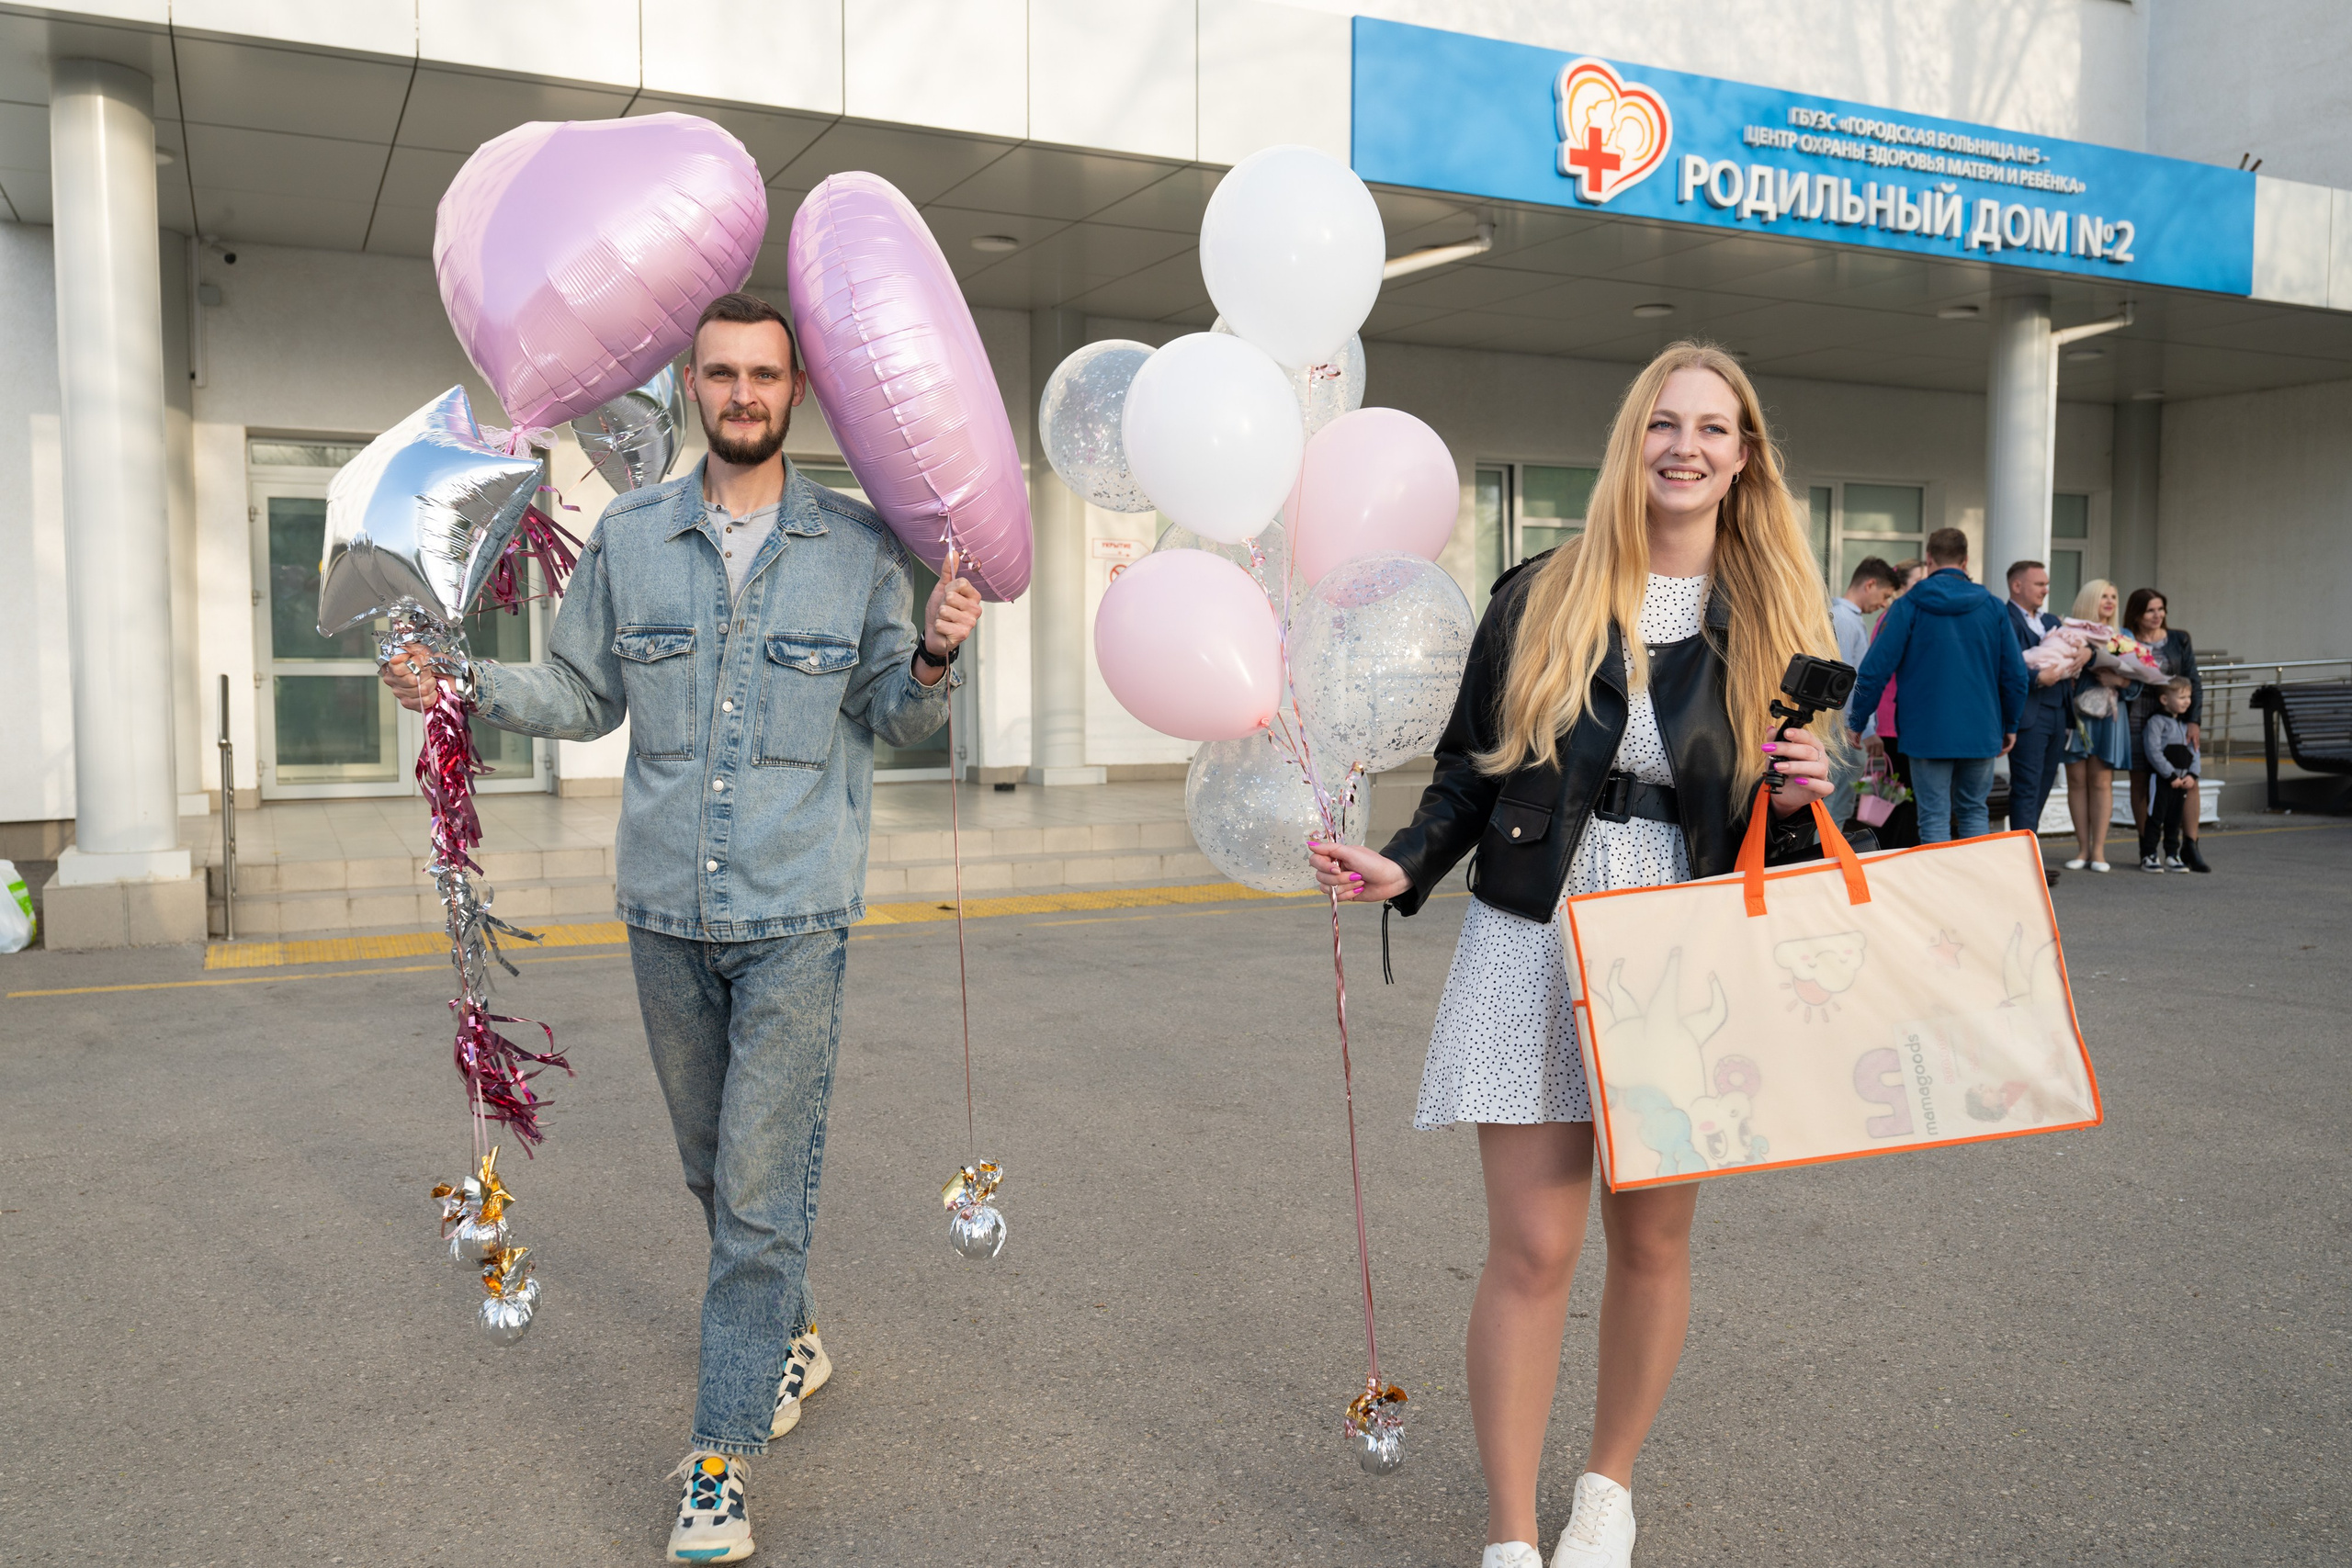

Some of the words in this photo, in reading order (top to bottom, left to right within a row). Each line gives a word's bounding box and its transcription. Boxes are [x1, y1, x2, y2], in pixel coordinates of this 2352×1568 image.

[1744, 125, 1798, 149] ЦЕНТР
[1798, 134, 1867, 161] ОХРАНЫ
[1868, 144, 1945, 173] ЗДОРОВЬЯ
[1947, 157, 2005, 182] МАТЕРИ
[2007, 166, 2018, 185] И
[2019, 168, 2086, 194] РЕБЁНКА»
[1788, 107, 1837, 130] ГБУЗС
[1838, 116, 1936, 147] «ГОРОДСКАЯ
[1938, 131, 2016, 162] БОЛЬНИЦА
[2018, 144, 2041, 164] №5
[1679, 154, 1962, 240] РОДИЛЬНЫЙ
[1967, 197, 2067, 253] ДОМ
[2073, 213, 2135, 263] №2
[1905, 1033, 1939, 1136] mamagoods
